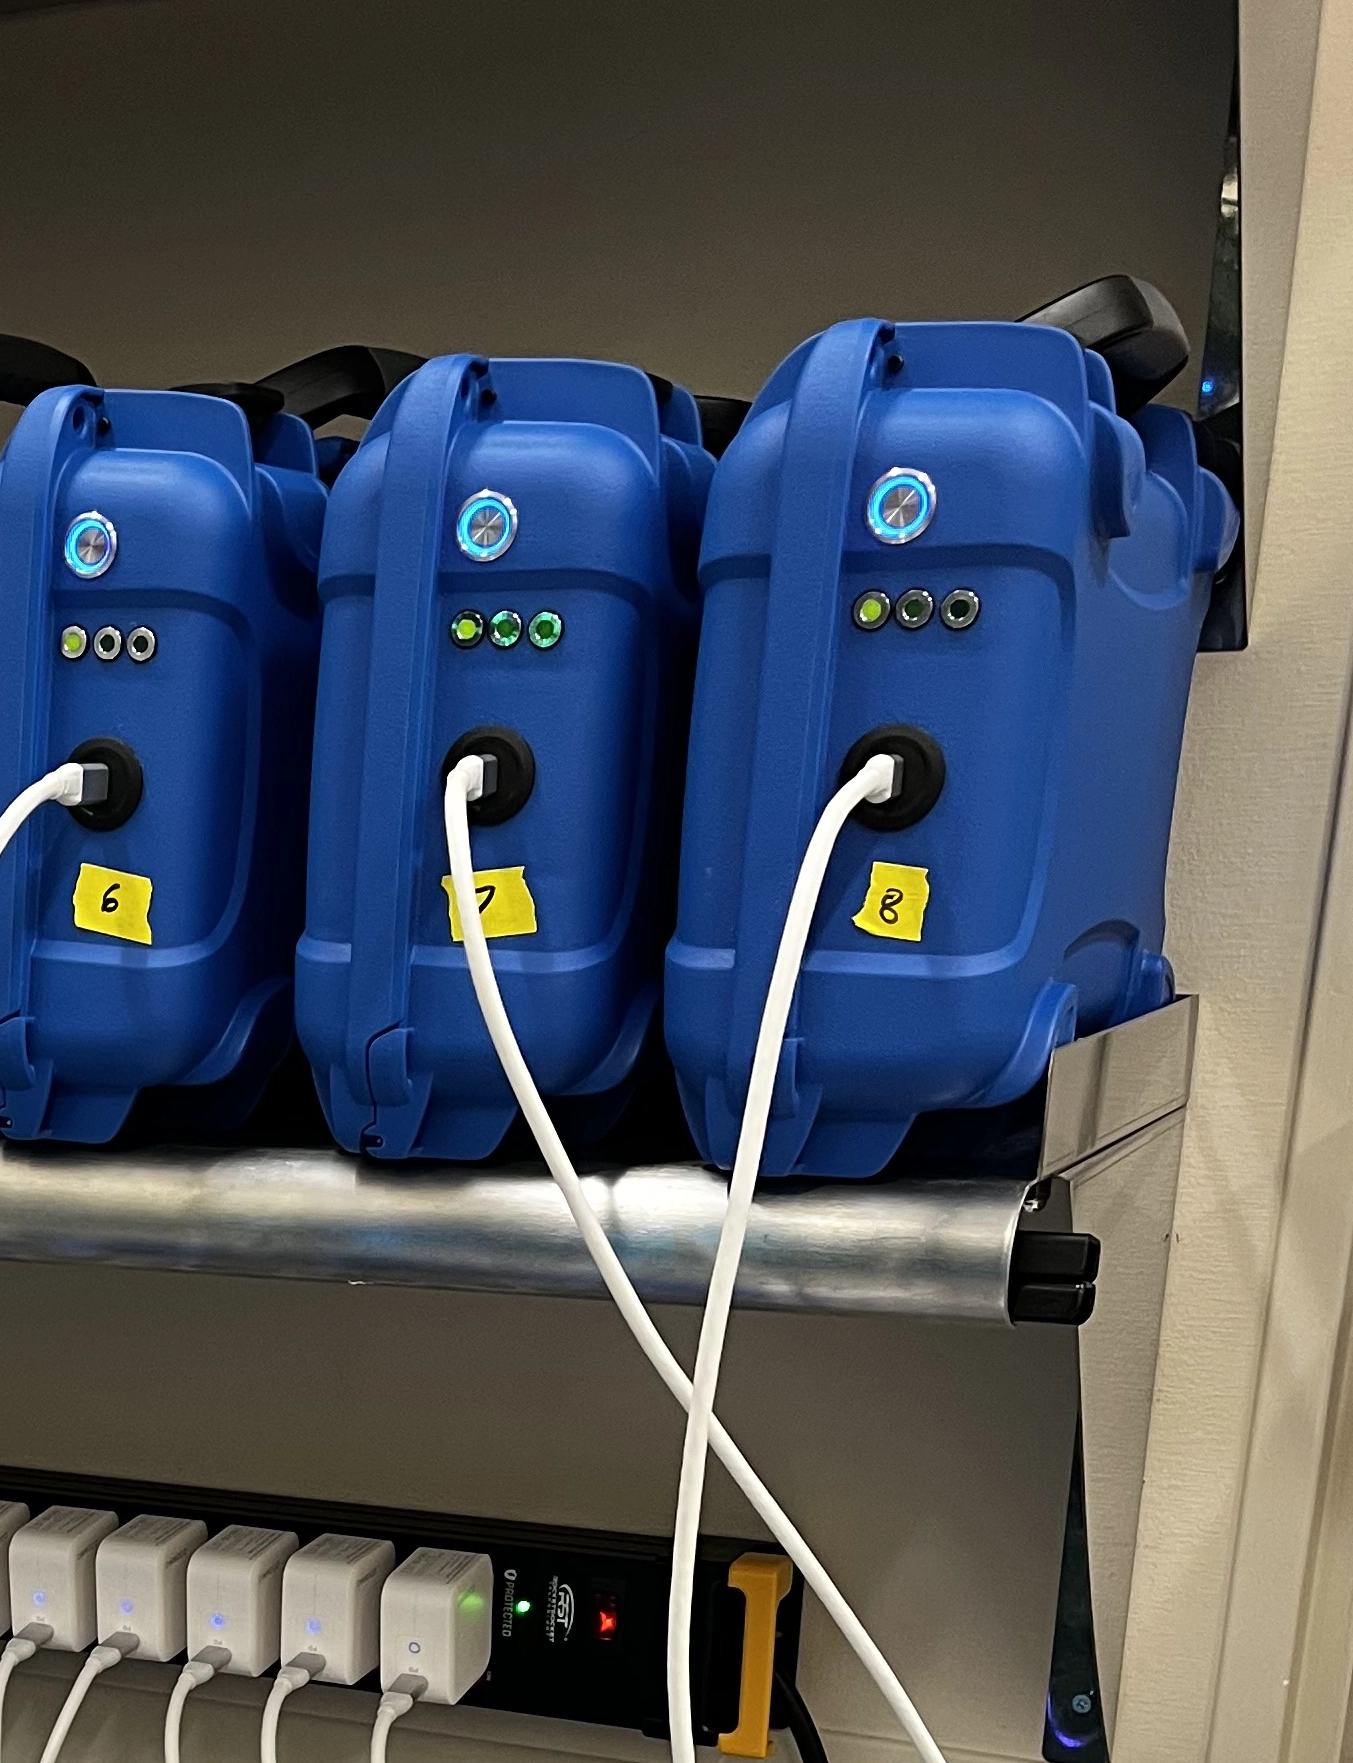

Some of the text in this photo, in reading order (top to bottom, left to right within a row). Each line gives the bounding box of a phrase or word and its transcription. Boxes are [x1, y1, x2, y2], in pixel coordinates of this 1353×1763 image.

[100, 882, 121, 913] 6
[474, 884, 496, 915] 7
[879, 887, 904, 925] 8
[501, 1581, 515, 1638] PROTECTED
